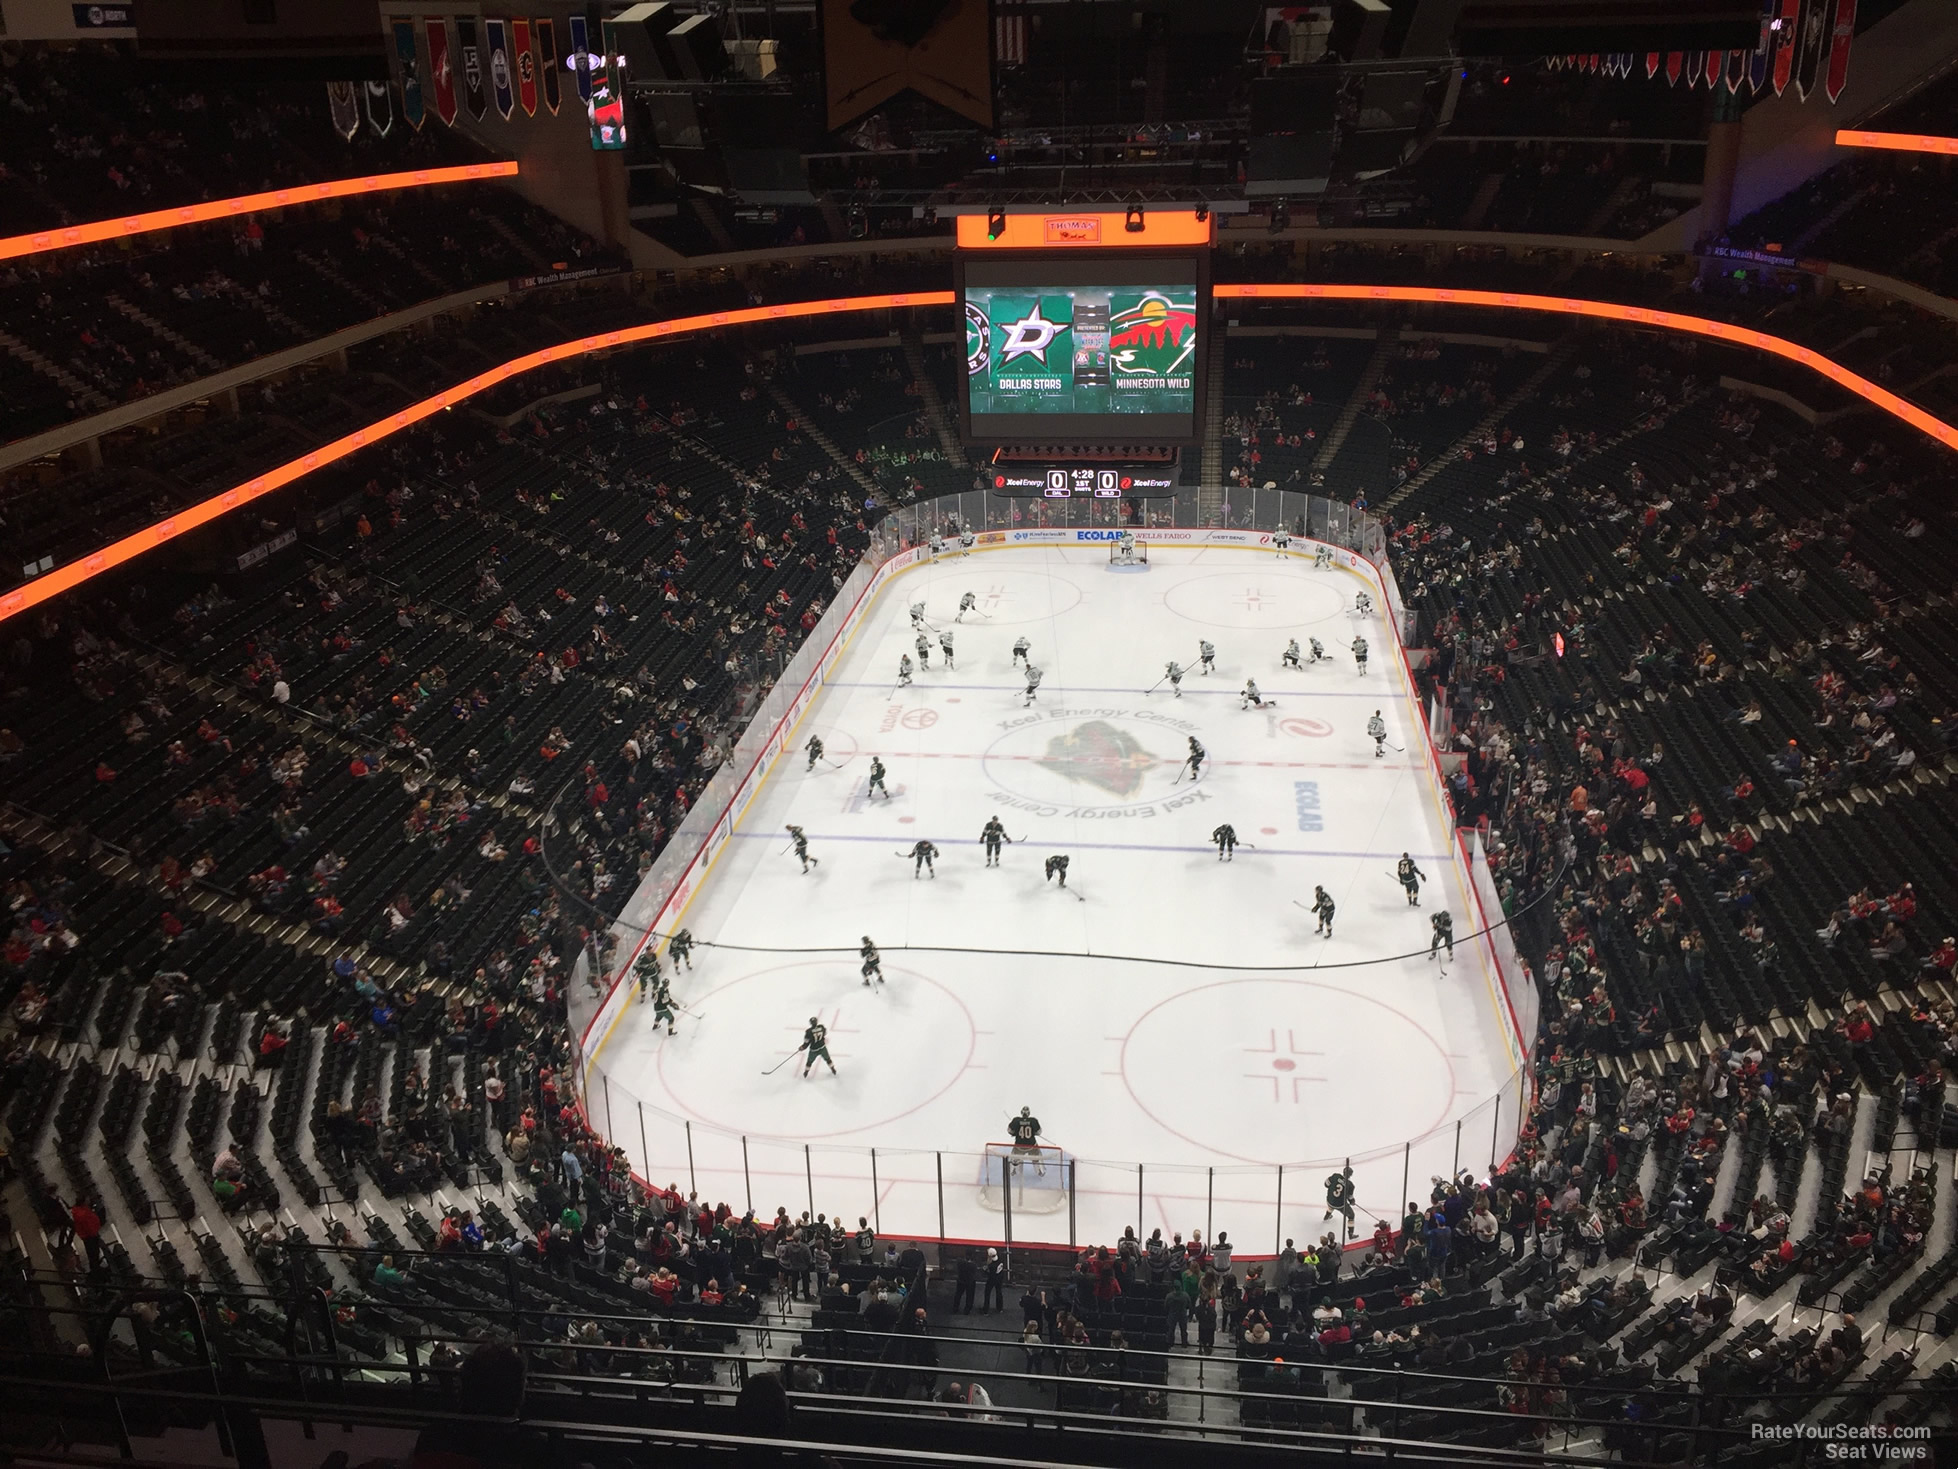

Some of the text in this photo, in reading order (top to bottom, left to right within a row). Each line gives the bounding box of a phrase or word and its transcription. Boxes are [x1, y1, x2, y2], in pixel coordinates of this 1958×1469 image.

[1730, 249, 1753, 259] Wealth
[1754, 252, 1795, 266] Management
[537, 274, 558, 284] Wealth
[560, 268, 597, 280] Management
[1000, 379, 1061, 389] DALLAS STARS
[1116, 378, 1190, 389] MINNESOTA WILD
[1051, 473, 1063, 488] 0
[1071, 470, 1094, 479] 4:28
[1102, 473, 1114, 488] 0
[1022, 479, 1044, 487] Energy
[1150, 480, 1172, 488] Energy
[997, 707, 1203, 732] Xcel Energy Center
[984, 791, 1059, 818] Center
[1065, 801, 1156, 819] Energy
[1294, 781, 1324, 832] ECOLAB
[1400, 863, 1410, 875] 24
[813, 1031, 824, 1044] 17
[1019, 1126, 1032, 1139] 40
[1333, 1184, 1343, 1197] 3
[860, 1236, 872, 1248] 40
